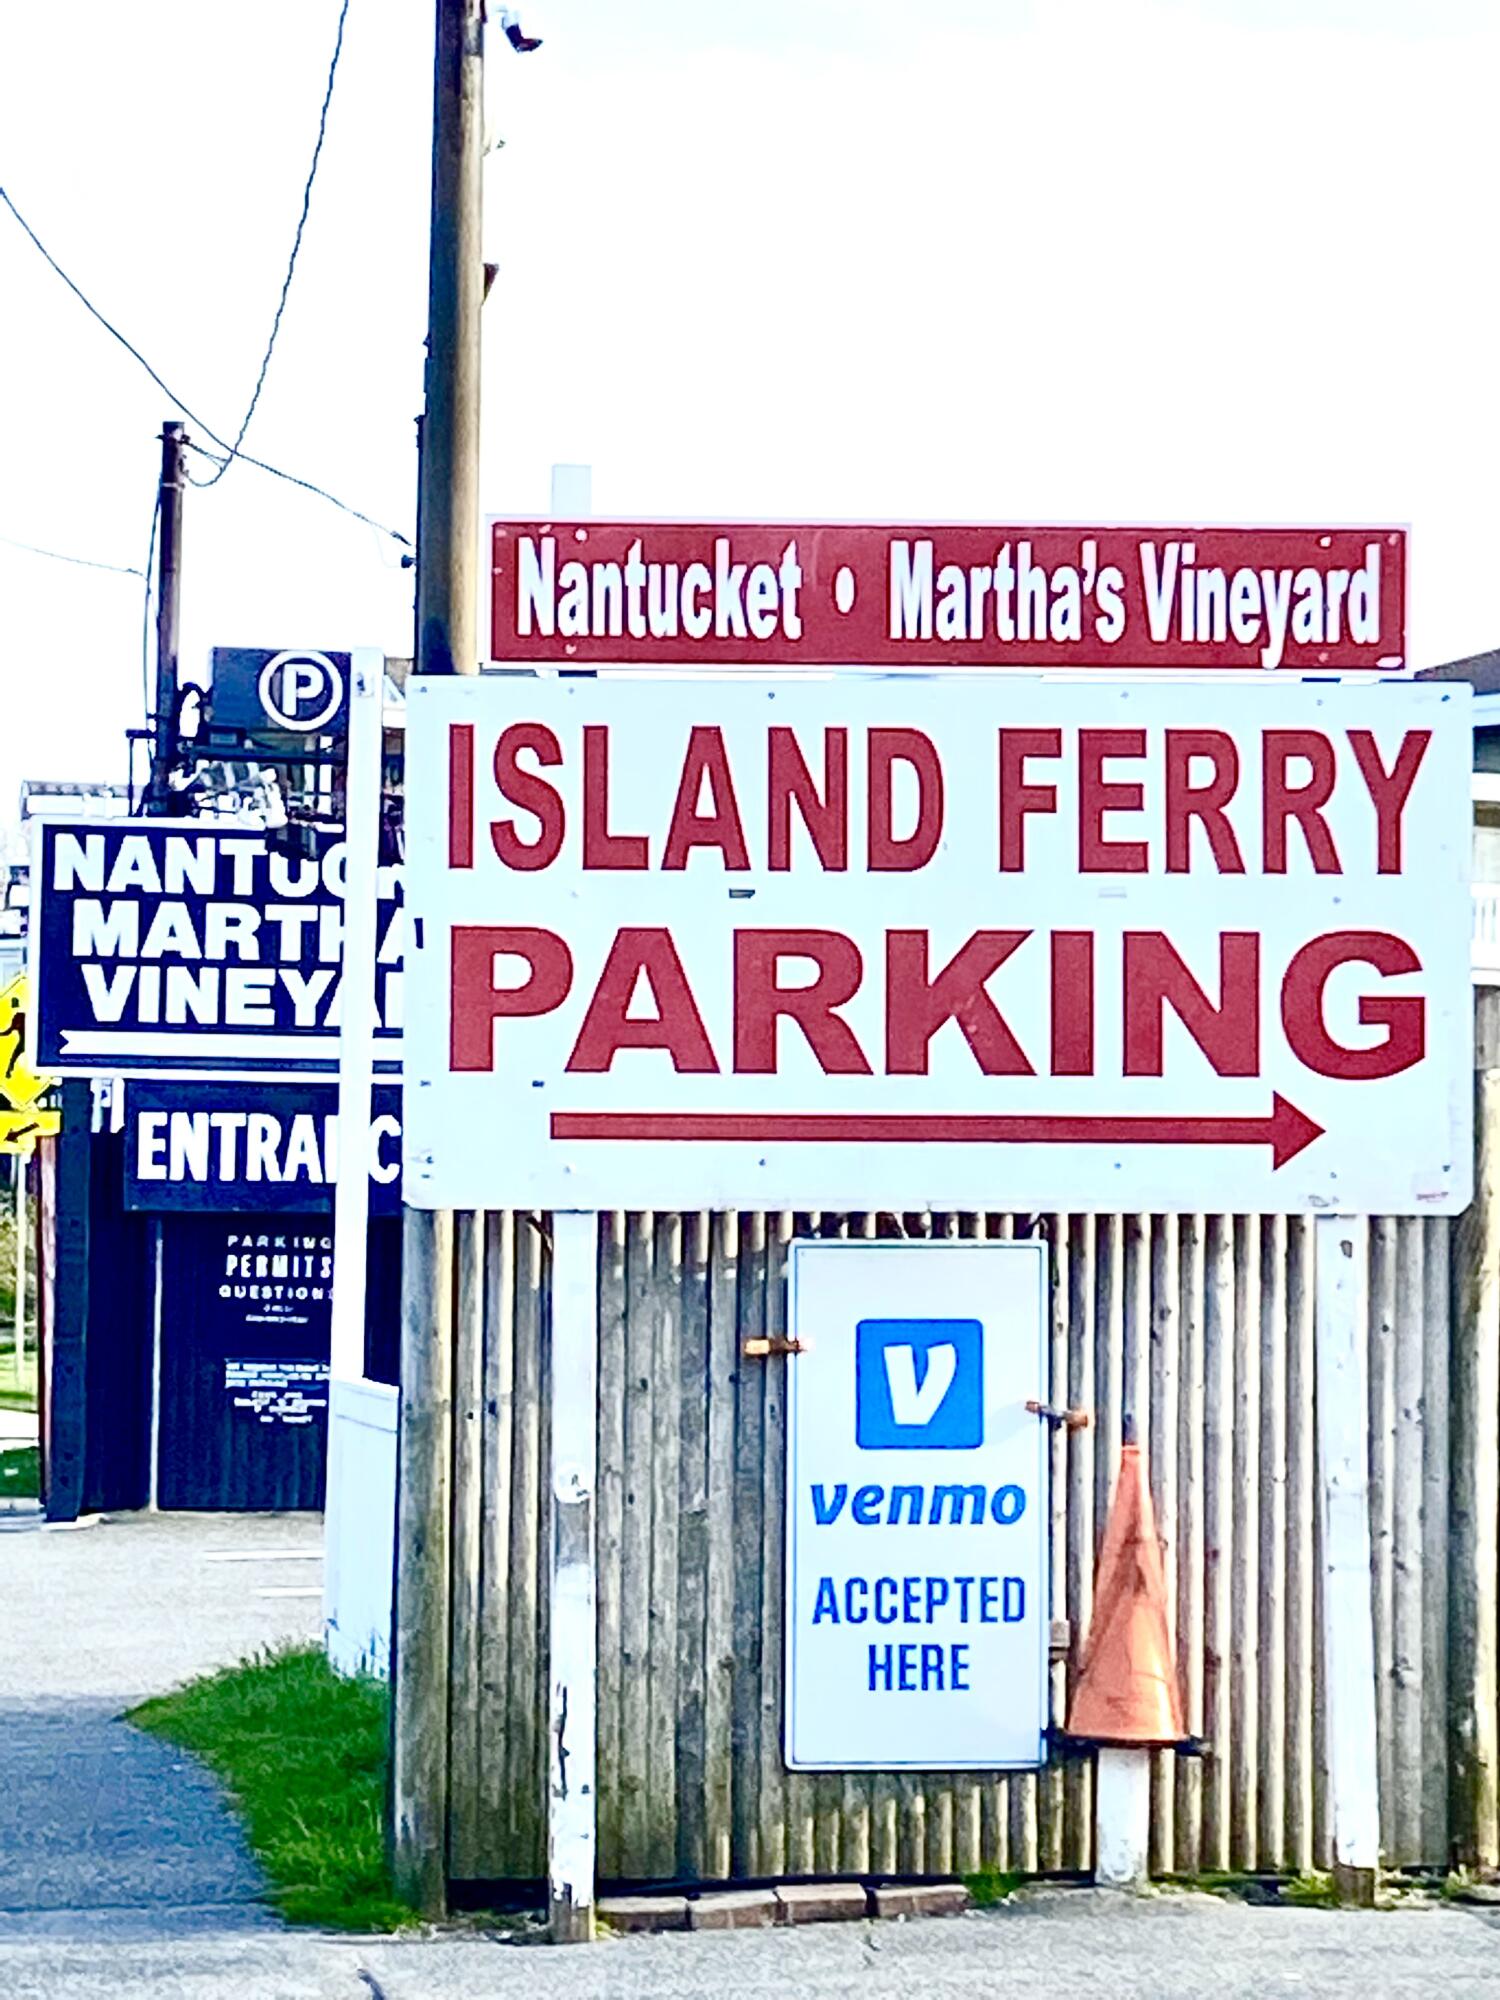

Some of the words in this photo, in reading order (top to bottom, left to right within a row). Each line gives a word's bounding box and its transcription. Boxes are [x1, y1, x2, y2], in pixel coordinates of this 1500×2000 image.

[517, 537, 803, 640] Nantucket
[889, 539, 1126, 643] Martha's
[1138, 540, 1382, 670] Vineyard
[281, 663, 325, 717] P
[448, 722, 945, 872] ISLAND
[999, 727, 1433, 875] FERRY
[448, 924, 1427, 1080] PARKING
[225, 1254, 332, 1278] PERMITS
[810, 1483, 1027, 1526] venmo
[811, 1576, 1026, 1625] ACCEPTED
[867, 1643, 970, 1692] HERE
